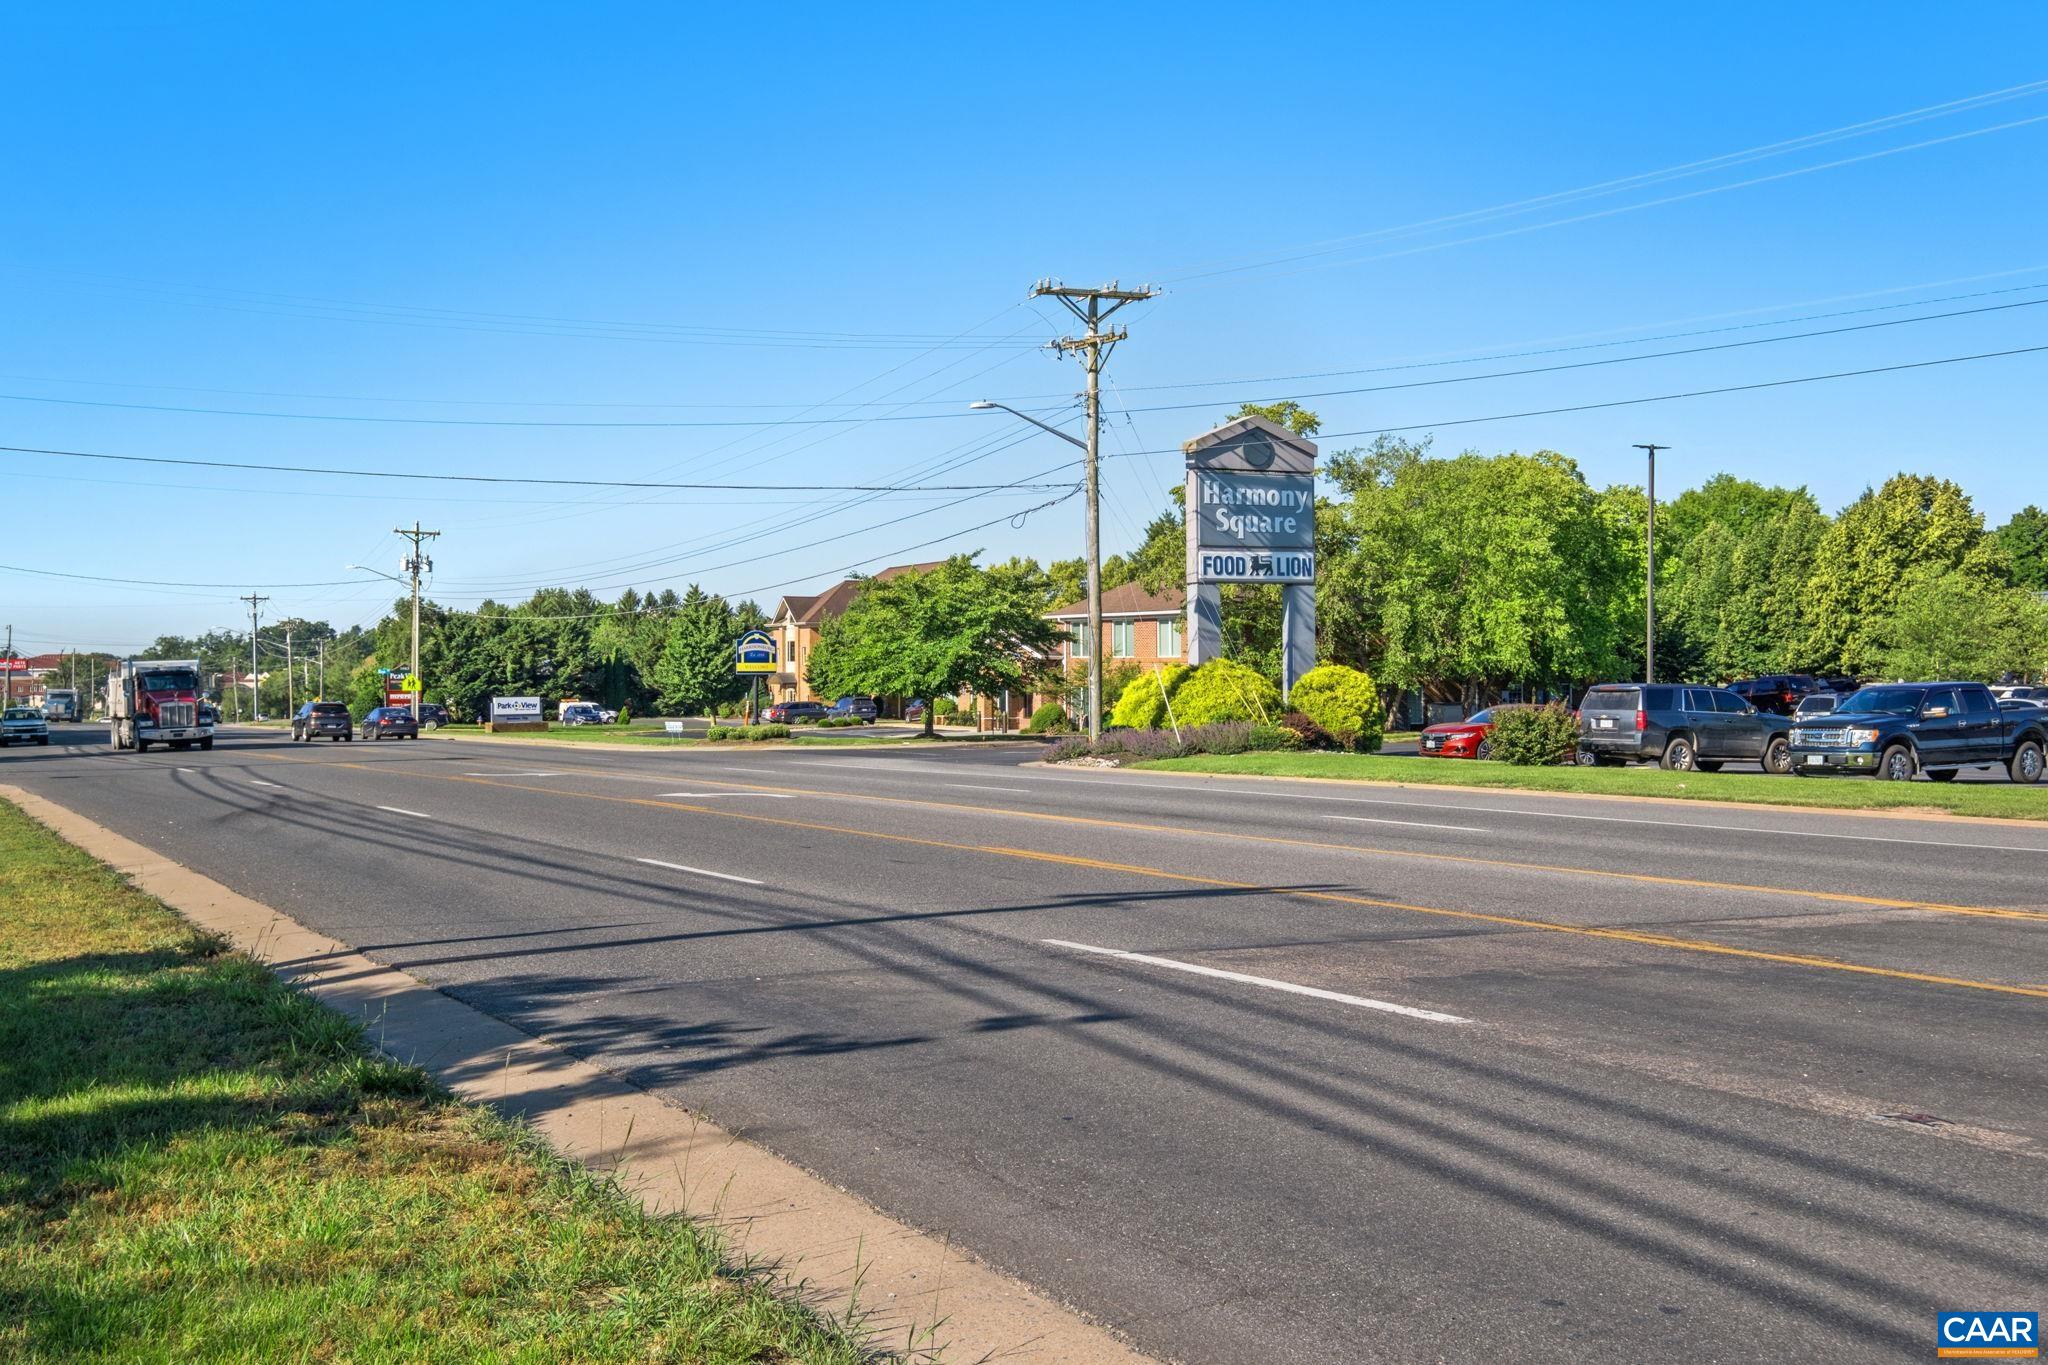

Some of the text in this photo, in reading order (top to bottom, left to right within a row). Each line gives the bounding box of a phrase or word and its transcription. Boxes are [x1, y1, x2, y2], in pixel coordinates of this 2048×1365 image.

[1203, 480, 1308, 514] Harmony
[1215, 507, 1297, 540] Square
[1203, 555, 1312, 577] FOOD LION
[521, 701, 538, 709] View
